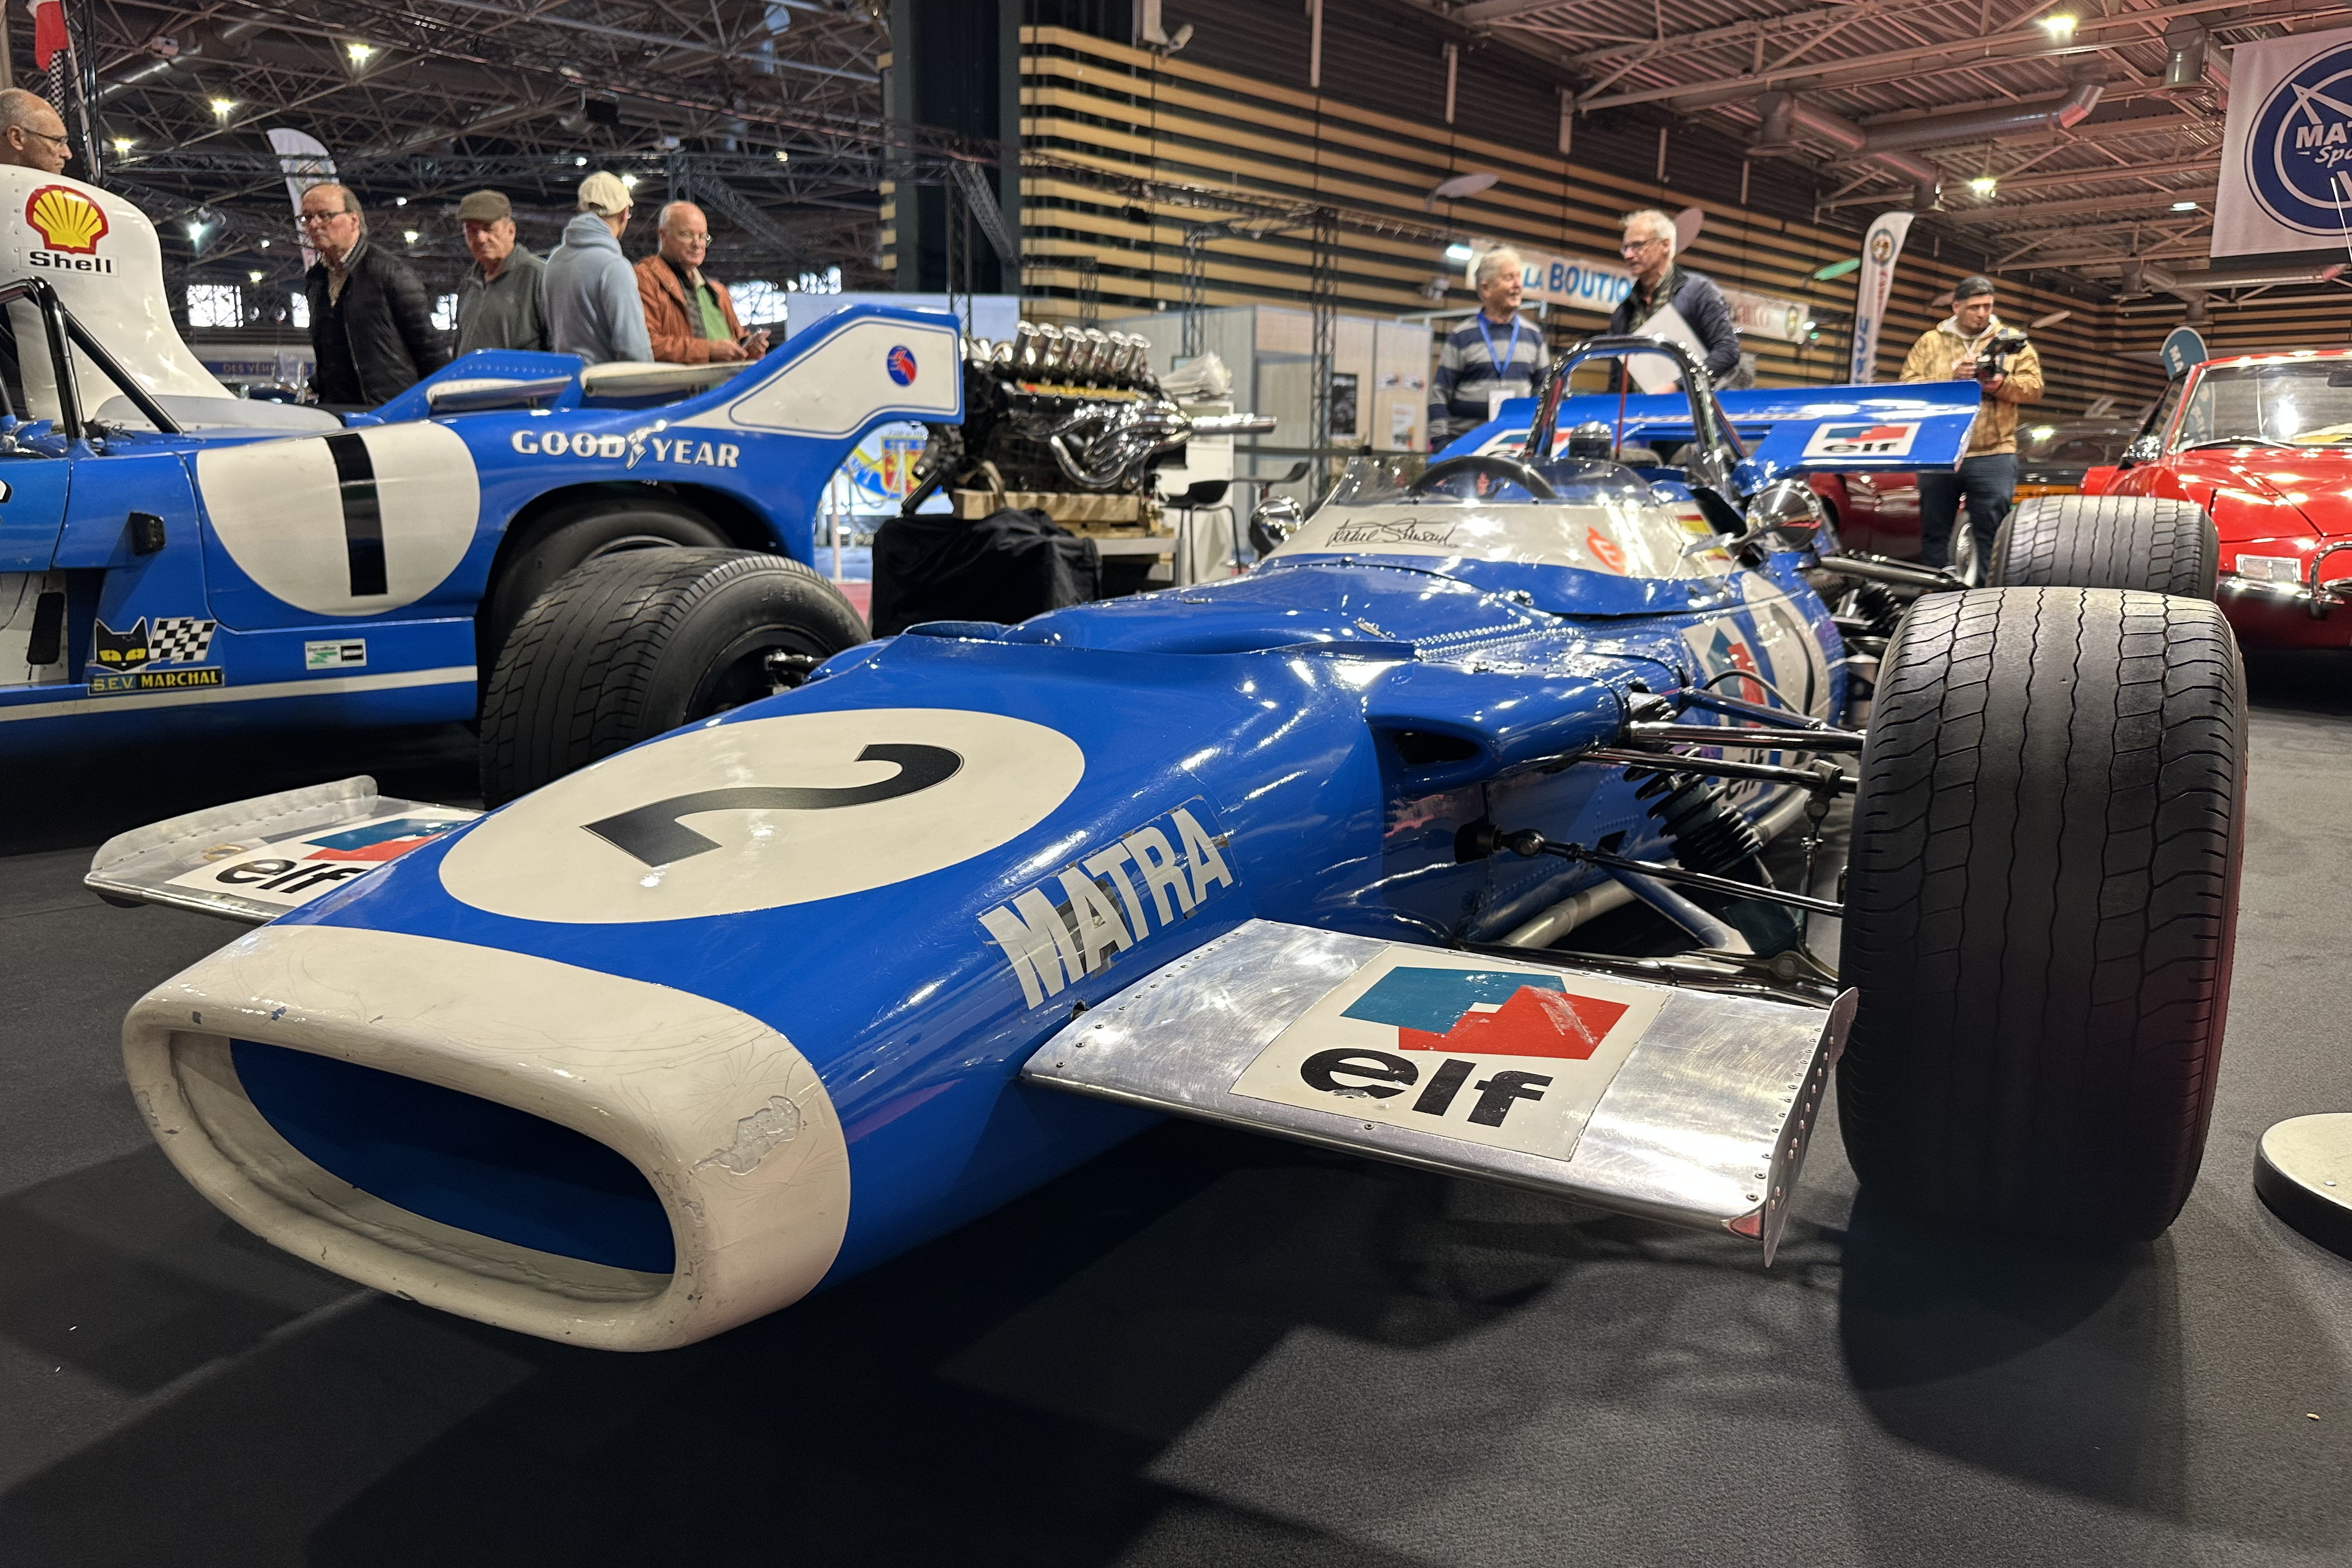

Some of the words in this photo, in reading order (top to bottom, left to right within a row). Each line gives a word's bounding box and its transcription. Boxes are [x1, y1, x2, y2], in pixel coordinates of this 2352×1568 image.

[2295, 121, 2352, 149] MA
[29, 251, 112, 273] Shell
[1822, 442, 1898, 453] elf
[323, 433, 388, 596] 1
[141, 670, 219, 688] MARCHAL
[580, 744, 965, 868] 2
[216, 859, 370, 894] elf
[978, 808, 1234, 1011] MATRA
[1300, 1048, 1555, 1128] elf
